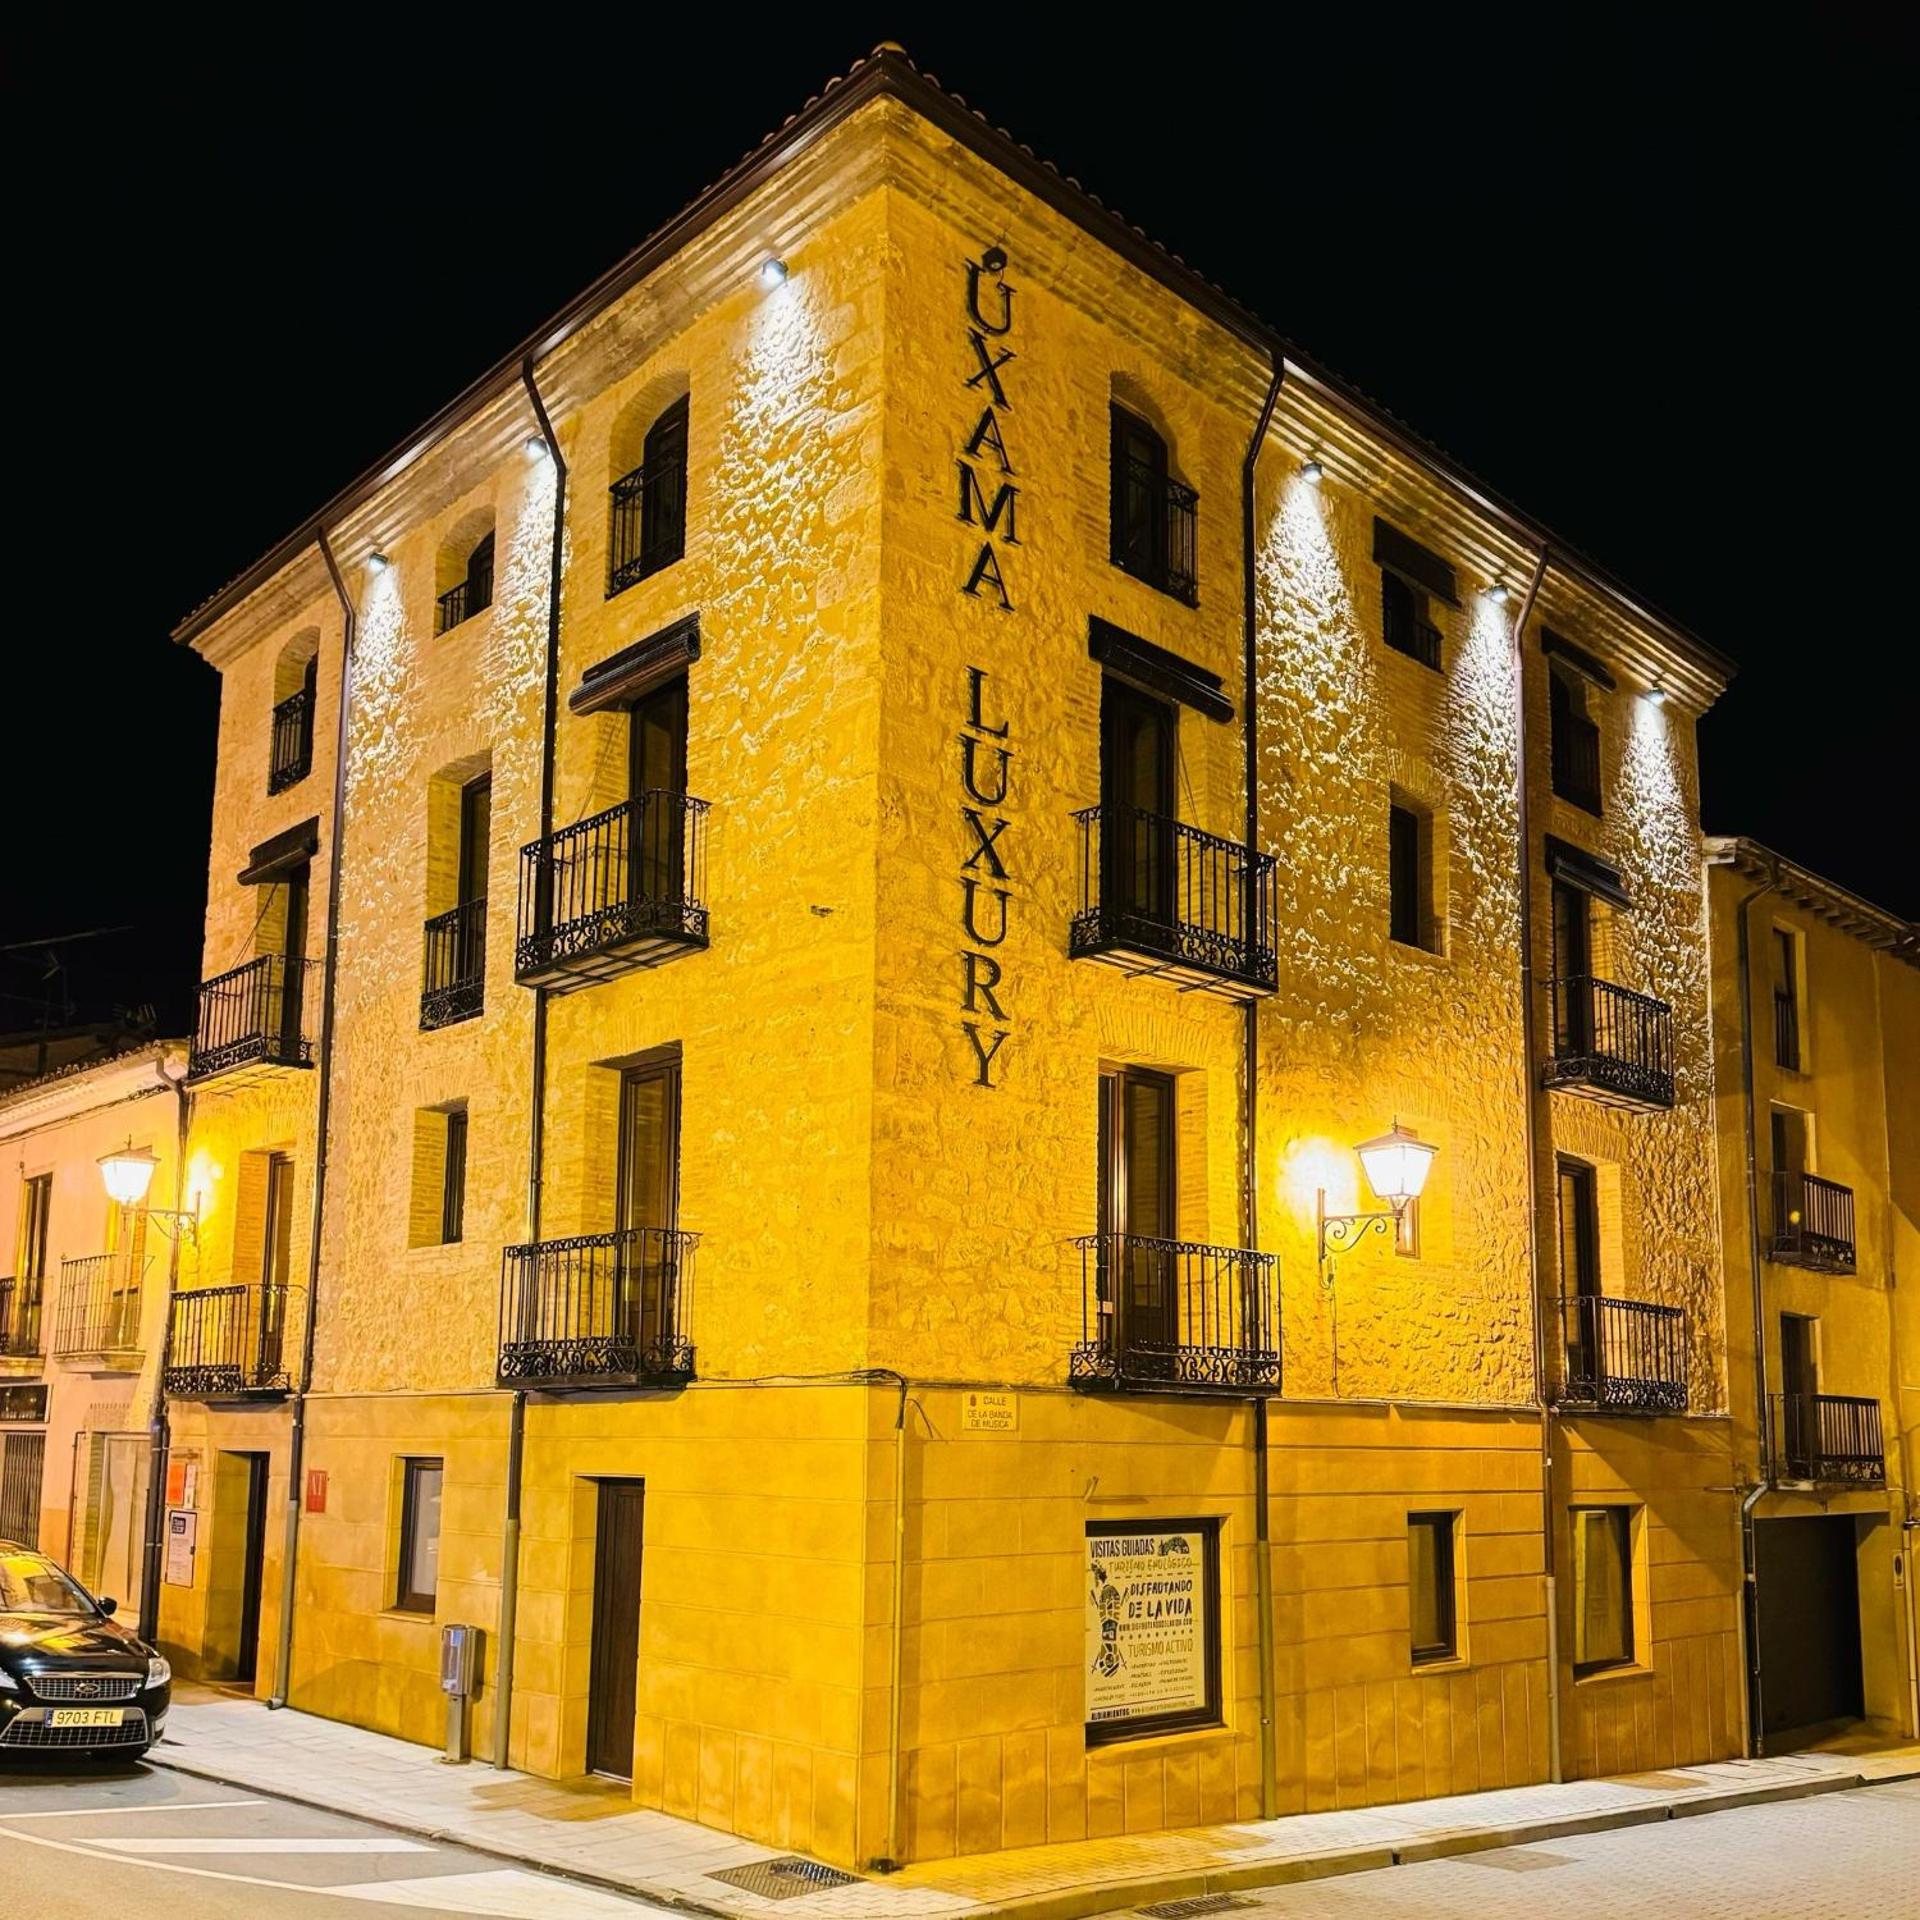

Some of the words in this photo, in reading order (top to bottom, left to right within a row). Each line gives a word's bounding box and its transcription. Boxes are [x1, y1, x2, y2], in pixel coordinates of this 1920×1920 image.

[955, 257, 1022, 613] UXAMA
[958, 664, 1013, 1089] LUXURY
[983, 1396, 1007, 1406] CALLE
[967, 1410, 978, 1419] DE
[979, 1410, 988, 1419] LA
[989, 1410, 1013, 1419] BANDA
[971, 1419, 980, 1428] DE
[1091, 1540, 1120, 1558] VISITAS
[1122, 1538, 1154, 1557] GUIADAS
[1130, 1580, 1192, 1596] DISFRUTANDO
[1128, 1601, 1142, 1618] DE
[1147, 1601, 1163, 1620] LA
[1165, 1598, 1192, 1617] VIDA
[1128, 1640, 1165, 1658] TURISMO
[1165, 1638, 1193, 1655] ACTIVO
[57, 1711, 89, 1725] 9703
[93, 1711, 117, 1723] FTL
